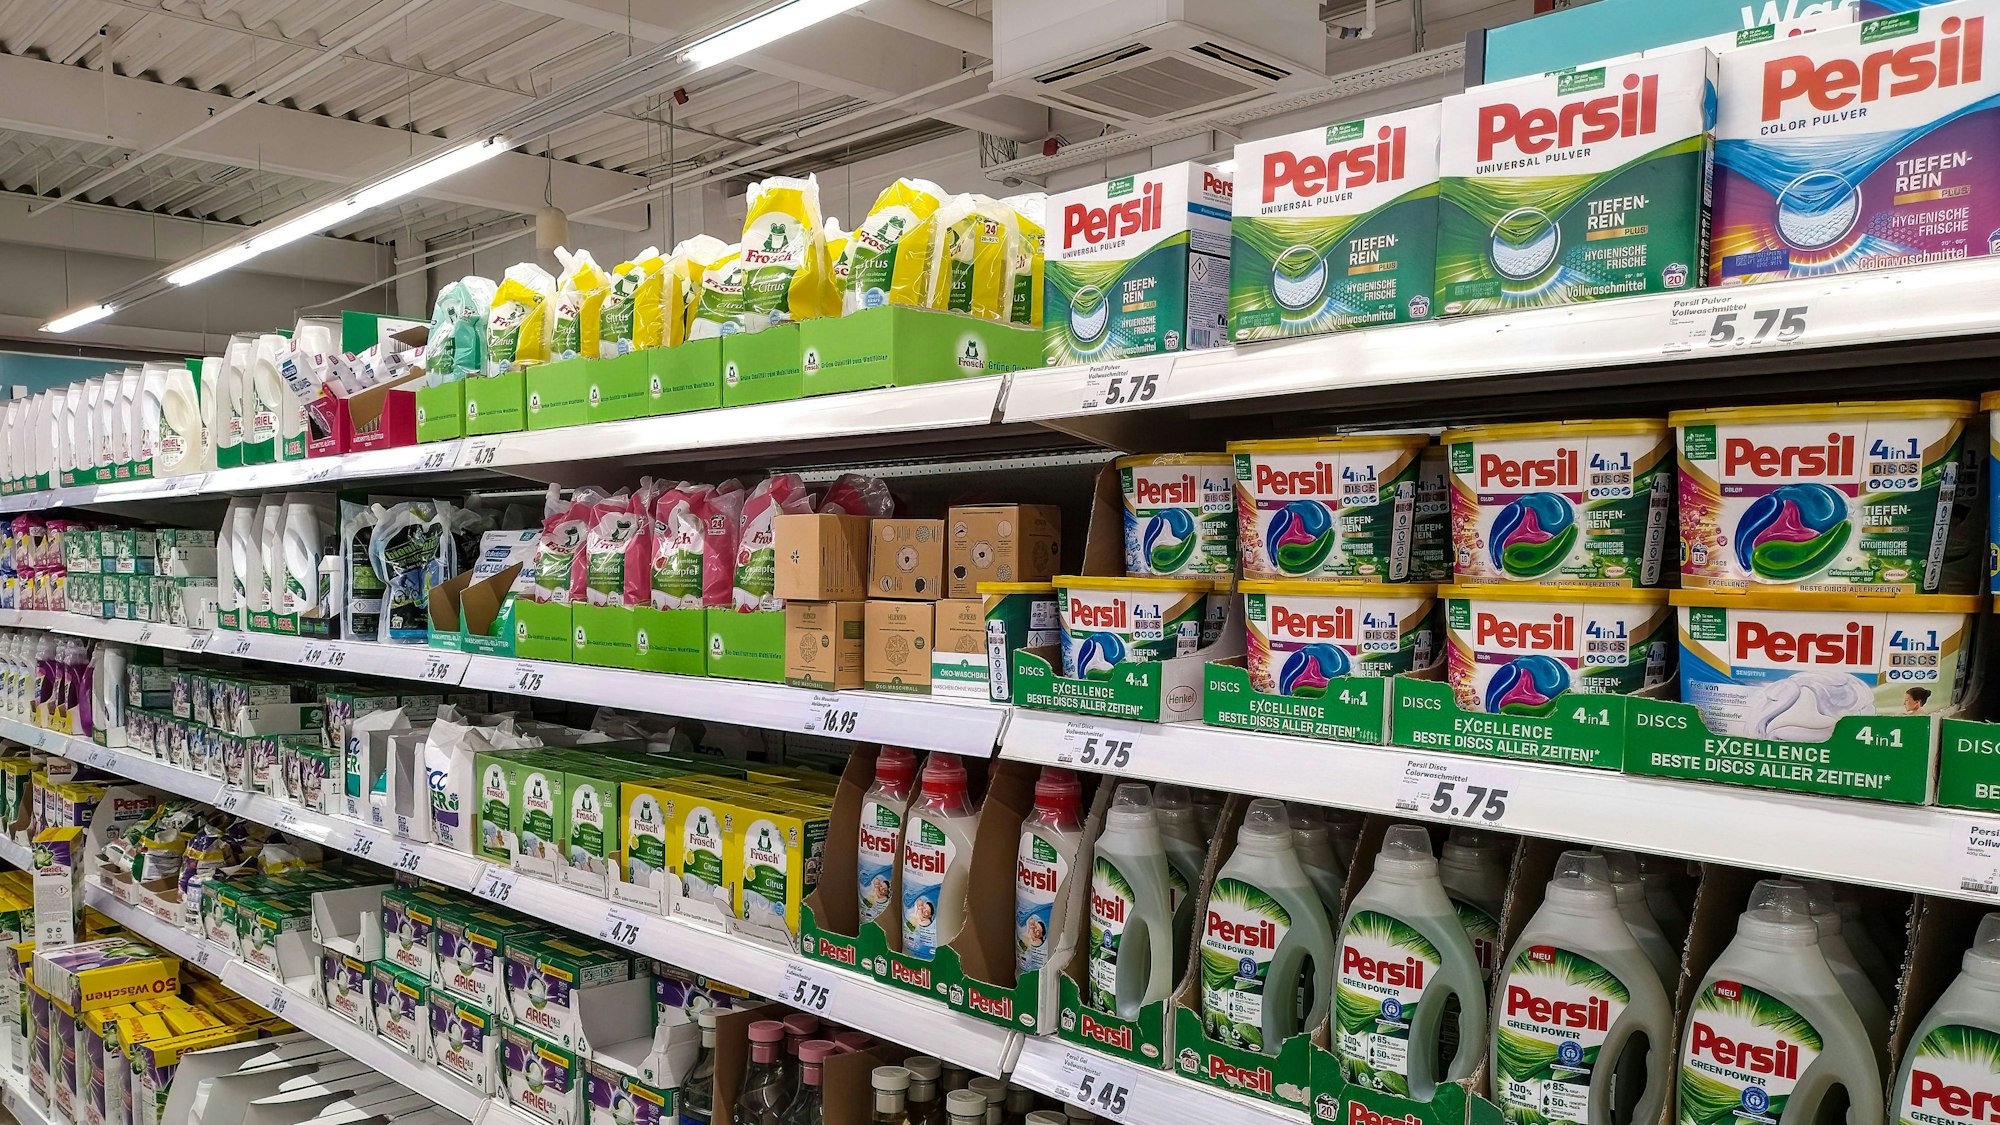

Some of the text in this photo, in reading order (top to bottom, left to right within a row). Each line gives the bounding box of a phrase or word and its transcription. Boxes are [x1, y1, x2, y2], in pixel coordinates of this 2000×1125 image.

[1761, 16, 1984, 122] Persil
[1477, 73, 1659, 162] Persil
[1760, 108, 1867, 136] COLOR PULVER
[1262, 125, 1406, 204] Persil
[1476, 148, 1591, 174] UNIVERSAL PULVER
[1896, 151, 1972, 176] TIEFEN-
[1896, 172, 1941, 192] REIN
[1262, 192, 1353, 215] UNIVERSAL PULVER
[1588, 195, 1649, 216] TIEFEN-
[1064, 182, 1162, 249] Persil
[1588, 213, 1625, 230] REIN
[1892, 207, 1969, 227] HYGIENISCHE
[1625, 226, 1646, 236] PLUS
[1919, 221, 1968, 237] FRISCHE
[1063, 240, 1125, 259] UNIVERSAL PULVER
[1350, 234, 1398, 251] TIEFEN-
[1349, 250, 1379, 265] REIN
[1585, 244, 1647, 261] HYGIENISCHE
[1859, 245, 1968, 271] Colorwaschmittel
[1606, 256, 1647, 270] FRISCHE
[1123, 277, 1157, 292] TIEFEN-
[1347, 279, 1396, 293] HYGIENISCHE
[1567, 279, 1646, 298] Vollwaschmittel
[1123, 291, 1144, 303] REIN
[1365, 288, 1396, 301] FRISCHE
[1333, 309, 1395, 326] Vollwaschmittel
[1672, 304, 1747, 317] Vollwaschmittel
[1134, 324, 1156, 334] FRISCHE
[1707, 306, 1808, 347] 5.75
[1106, 375, 1159, 405] 5.75
[475, 448, 496, 464] 4.75
[1725, 432, 1855, 477] Persil
[1869, 438, 1921, 460] 4in1
[424, 453, 445, 469] 4.75
[1480, 447, 1578, 488] Persil
[1589, 452, 1631, 471] 4in1
[1871, 462, 1919, 474] DISCS
[1256, 461, 1334, 495] Persil
[1136, 474, 1196, 504] Persil
[1586, 510, 1626, 520] TIEFEN-
[1863, 504, 1911, 517] TIEFEN-
[1341, 516, 1374, 525] TIEFEN-
[1341, 523, 1362, 533] REIN
[1586, 519, 1611, 529] REIN
[1863, 515, 1893, 526] REIN
[1861, 540, 1908, 551] HYGIENISCHE
[1877, 548, 1908, 556] FRISCHE
[1071, 598, 1126, 629] Persil
[1133, 604, 1162, 619] 4in1
[1362, 612, 1398, 629] 4in1
[1271, 606, 1353, 640] Persil
[1476, 613, 1574, 651] Persil
[1586, 620, 1628, 640] 4in1
[1365, 631, 1397, 640] DISCS
[1736, 621, 1874, 666] Persil
[1888, 630, 1940, 651] 4in1
[1588, 641, 1626, 652] DISCS
[305, 649, 321, 663] 4.99
[329, 652, 345, 666] 4.95
[1891, 653, 1937, 667] DISCS
[429, 663, 450, 679] 3.95
[1019, 665, 1045, 677] DISCS
[1360, 662, 1394, 671] TIEFEN-
[1735, 669, 1766, 678] SENSITIVE
[519, 674, 543, 691] 4.75
[1125, 672, 1149, 688] 4in1
[1209, 680, 1240, 693] DISCS
[1582, 676, 1621, 687] TIEFEN-
[1053, 682, 1114, 699] EXCELLENCE
[1168, 694, 1194, 705] Henkel
[1339, 690, 1368, 706] 4in1
[1027, 694, 1052, 706] BESTE
[1053, 696, 1078, 708] DISCS
[1080, 699, 1106, 712] ALLER
[1250, 700, 1324, 719] EXCELLENCE
[1402, 696, 1441, 710] DISCS
[823, 709, 858, 733] 16.95
[1219, 712, 1248, 724] BESTE
[1250, 715, 1280, 729] DISCS
[1282, 721, 1314, 733] ALLER
[1572, 707, 1610, 726] 4in1
[1637, 713, 1688, 729] DISCS
[1454, 717, 1553, 740] EXCELLENCE
[1855, 726, 1904, 748] 4in1
[1413, 731, 1451, 746] BESTE
[1454, 736, 1493, 752] DISCS
[1496, 740, 1539, 756] ALLER
[1704, 737, 1831, 764] EXCELLENCE
[1080, 738, 1132, 768] 5.75
[1407, 760, 1448, 772] Persil Discs
[1651, 752, 1701, 770] BESTE
[1705, 758, 1755, 776] DISCS
[1759, 763, 1813, 782] ALLER
[1405, 769, 1469, 783] Colorwaschmittel
[486, 787, 504, 799] Frosch
[1430, 782, 1509, 822] 5.75
[528, 797, 548, 809] Frosch
[576, 809, 598, 822] Frosch
[634, 819, 659, 834] Frosch
[353, 839, 372, 855] 5.45
[689, 833, 716, 849] Frosch
[400, 852, 421, 871] 5.45
[750, 848, 780, 865] Frosch
[905, 845, 945, 874] Persil
[704, 862, 720, 873] Citrus
[1017, 860, 1057, 893] Persil
[489, 880, 512, 901] 4.75
[765, 879, 784, 890] Citrus
[611, 921, 640, 945] 4.75
[1208, 911, 1275, 949] Persil
[819, 938, 856, 965] Persil
[1206, 939, 1255, 957] GREEN POWER
[1533, 953, 1550, 961] NEU
[396, 949, 417, 967] ARIEL
[891, 960, 931, 989] Persil
[1343, 945, 1424, 990] Persil
[152, 977, 176, 994] 50
[454, 974, 478, 993] ARIEL
[1343, 978, 1400, 997] GREEN POWER
[1717, 987, 1737, 998] NEU
[336, 995, 353, 1011] ARIEL
[791, 981, 830, 1011] 5.75
[969, 988, 1013, 1019] Persil
[1508, 985, 1609, 1031] Persil
[525, 1007, 553, 1029] ARIEL
[386, 1020, 405, 1039] ARIEL
[1081, 1013, 1132, 1050] Persil
[1507, 1020, 1581, 1040] GREEN POWER
[445, 1050, 467, 1069] ARIEL
[1691, 1021, 1798, 1080] Persil
[1691, 1058, 1767, 1087] GREEN POWER
[1076, 1075, 1129, 1115] 5.45
[1508, 1082, 1532, 1096] 100%
[522, 1090, 549, 1113] ARIEL
[1321, 1106, 1332, 1116] 20
